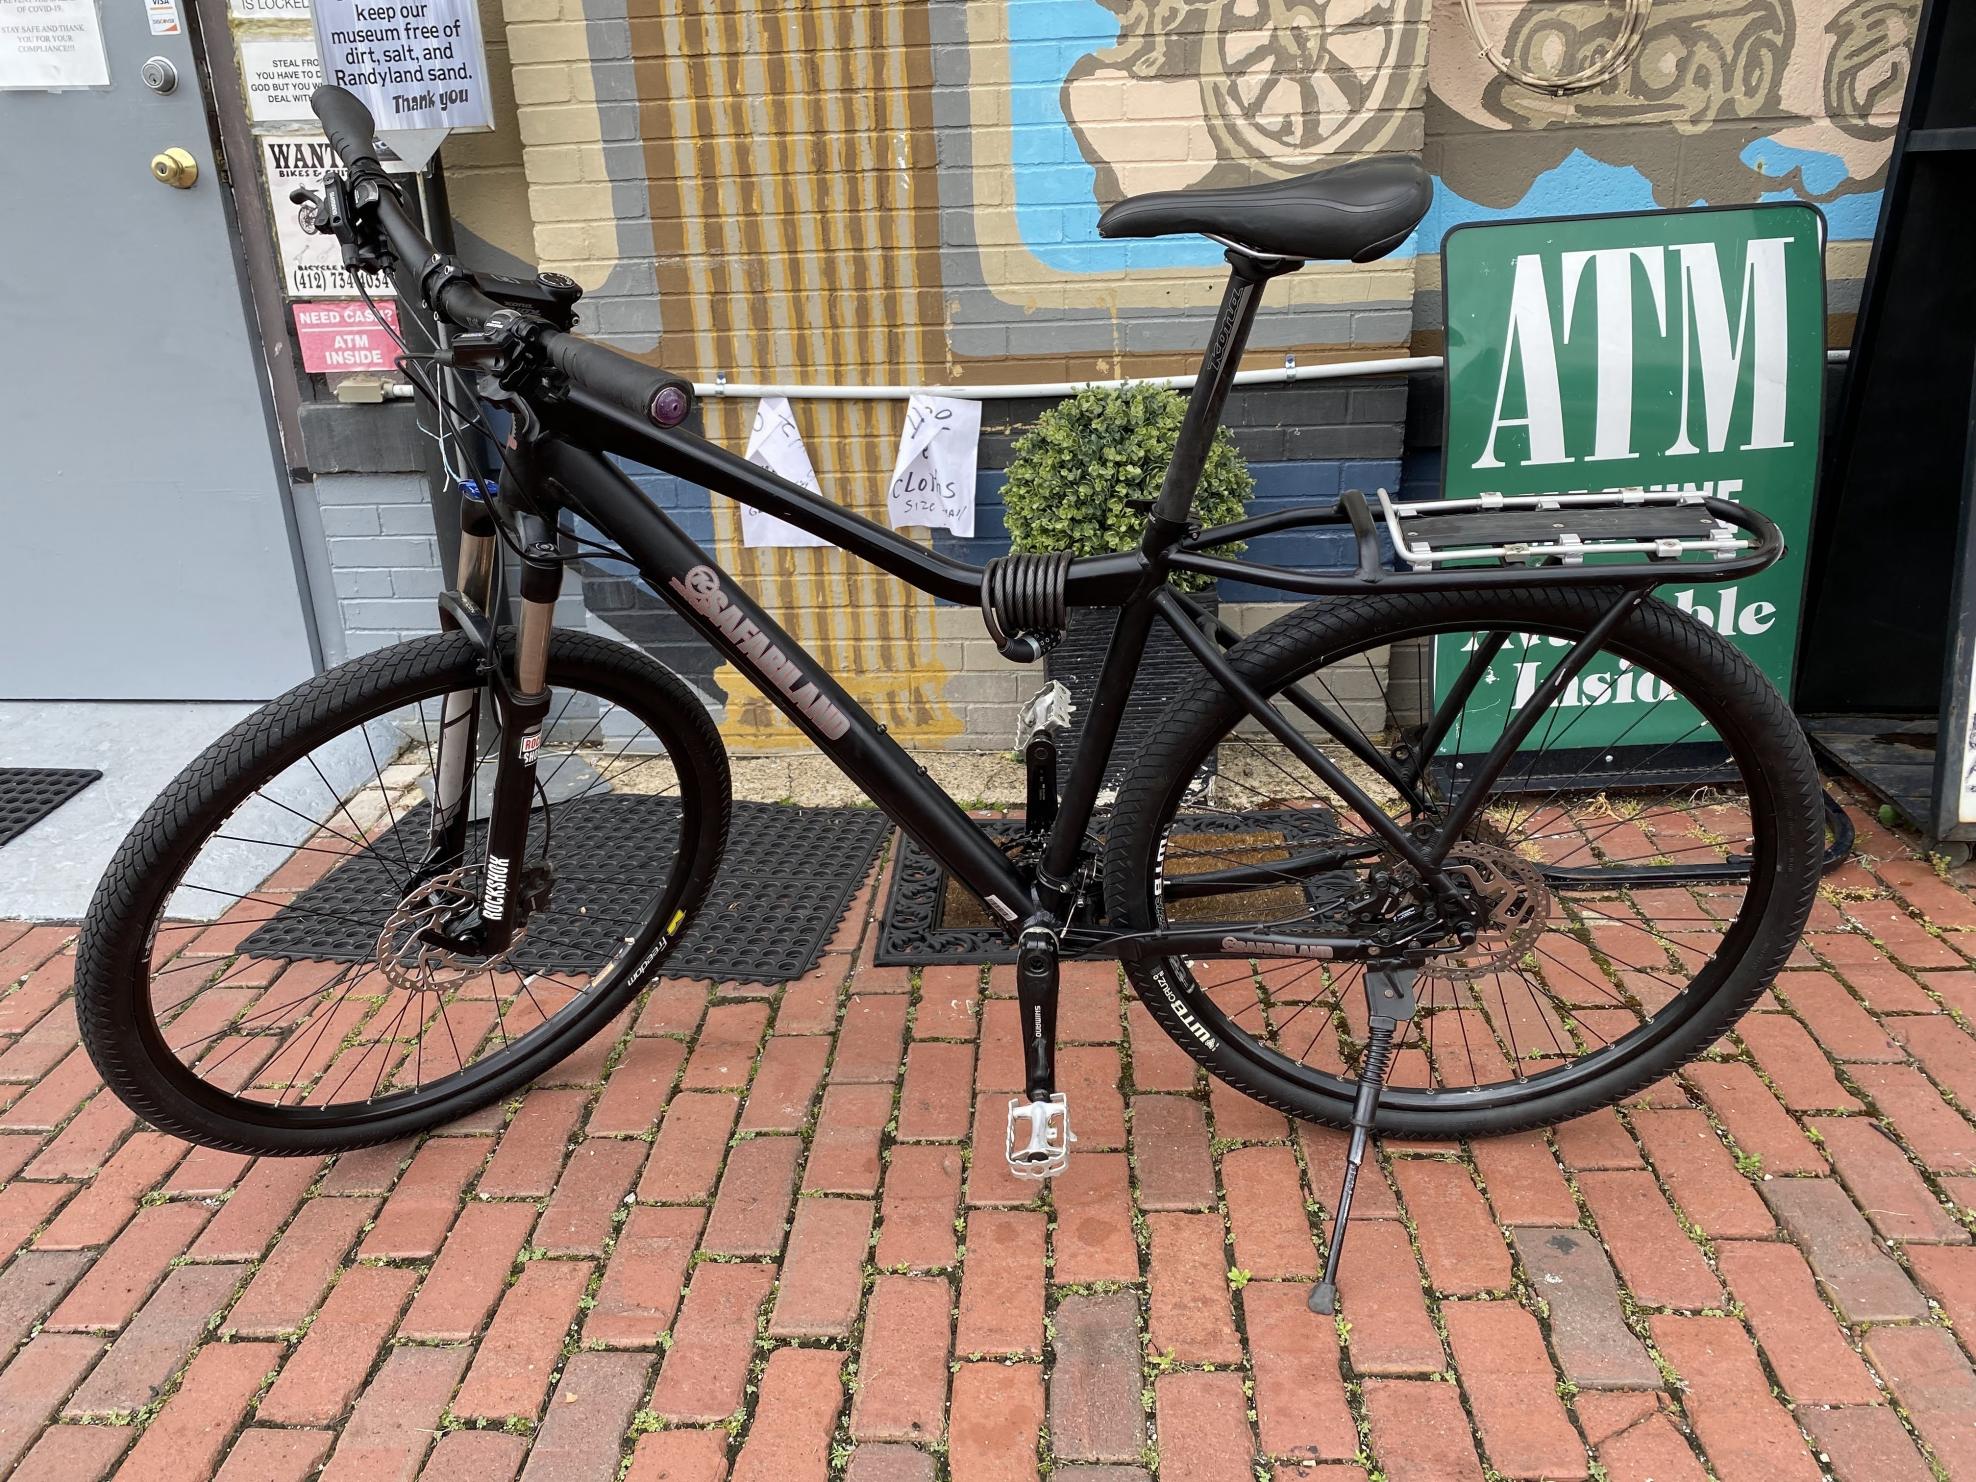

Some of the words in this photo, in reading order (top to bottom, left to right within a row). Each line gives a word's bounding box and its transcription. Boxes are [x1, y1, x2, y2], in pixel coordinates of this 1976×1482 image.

[243, 0, 254, 9] IS
[355, 4, 396, 22] keep
[401, 4, 427, 18] our
[332, 26, 400, 45] museum
[404, 22, 439, 40] free
[443, 19, 461, 38] of
[272, 60, 300, 68] STEAL
[302, 58, 319, 67] FRO
[345, 47, 380, 65] dirt,
[384, 44, 420, 63] salt,
[423, 42, 454, 60] and
[256, 72, 275, 80] YOU
[277, 70, 300, 79] HAVE
[302, 70, 314, 79] TO
[334, 65, 424, 87] Randyland
[428, 62, 472, 81] sand.
[250, 84, 270, 92] GOD
[272, 83, 290, 91] BUT
[292, 82, 311, 91] YOU
[268, 95, 290, 103] DEAL
[392, 90, 436, 114] Thank
[439, 88, 469, 111] you
[294, 270, 326, 292] (412)
[300, 311, 339, 324] NEED
[343, 309, 393, 323] CAS?
[334, 335, 369, 349] ATM
[1472, 237, 1794, 469] ATM
[325, 350, 384, 365] INSIDE
[1512, 659, 1680, 710] Insid
[525, 736, 541, 750] ROC
[482, 855, 510, 921] ROCKSHOX
[1157, 977, 1177, 1001] CRUZ
[1034, 1005, 1042, 1038] SHIMANO
[1170, 999, 1212, 1045] WTB
